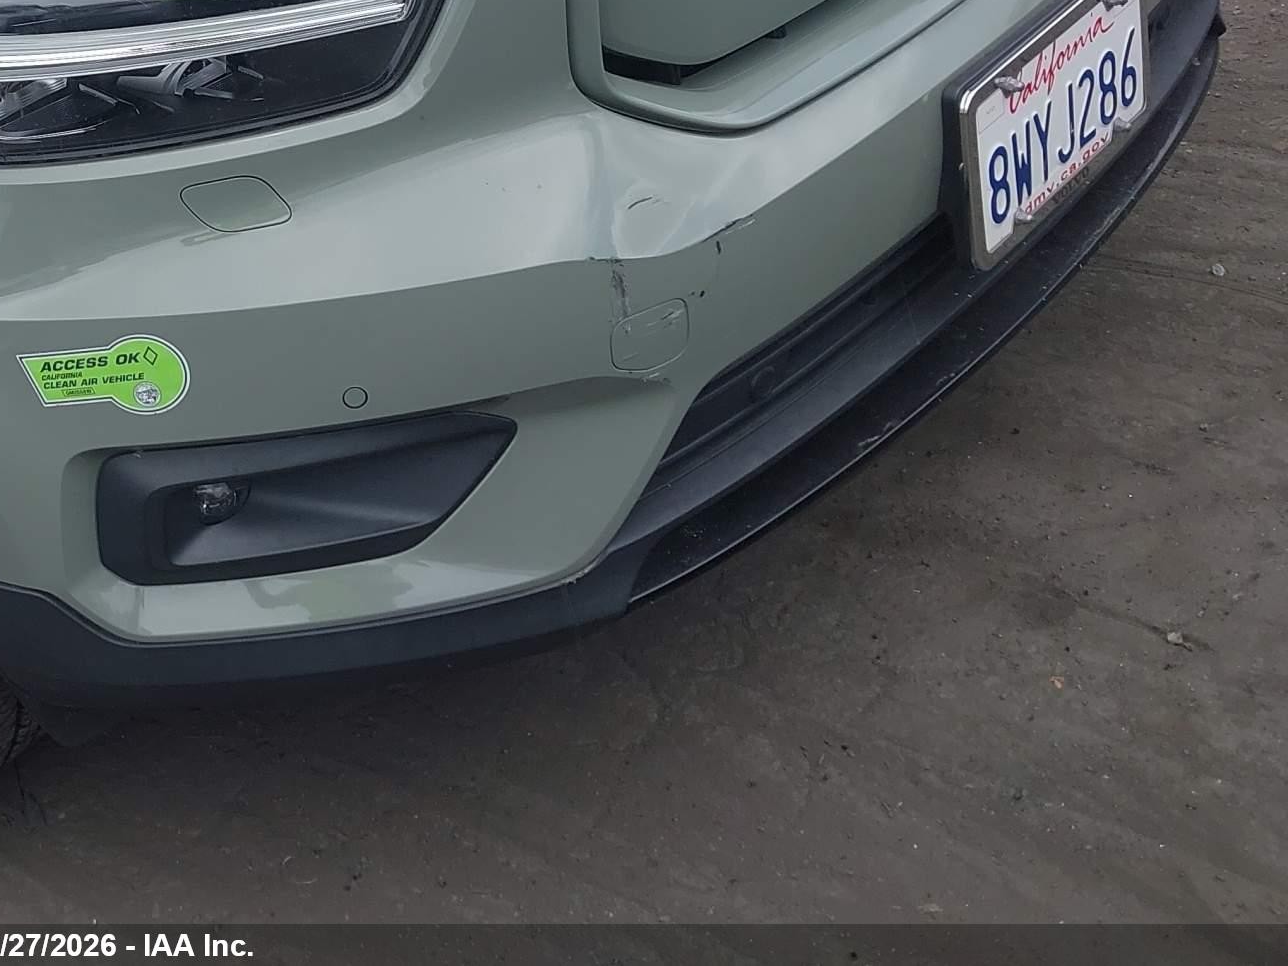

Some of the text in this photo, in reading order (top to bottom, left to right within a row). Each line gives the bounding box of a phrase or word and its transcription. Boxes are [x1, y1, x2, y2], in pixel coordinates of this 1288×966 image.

[1007, 12, 1115, 114] California
[987, 26, 1138, 226] 8WYJ286
[1025, 131, 1110, 215] dmv.ca.gov
[40, 352, 140, 373] ACCESS OK
[41, 371, 83, 381] CALIFORNIA
[43, 372, 145, 390] CLEAN AIR VEHICLE
